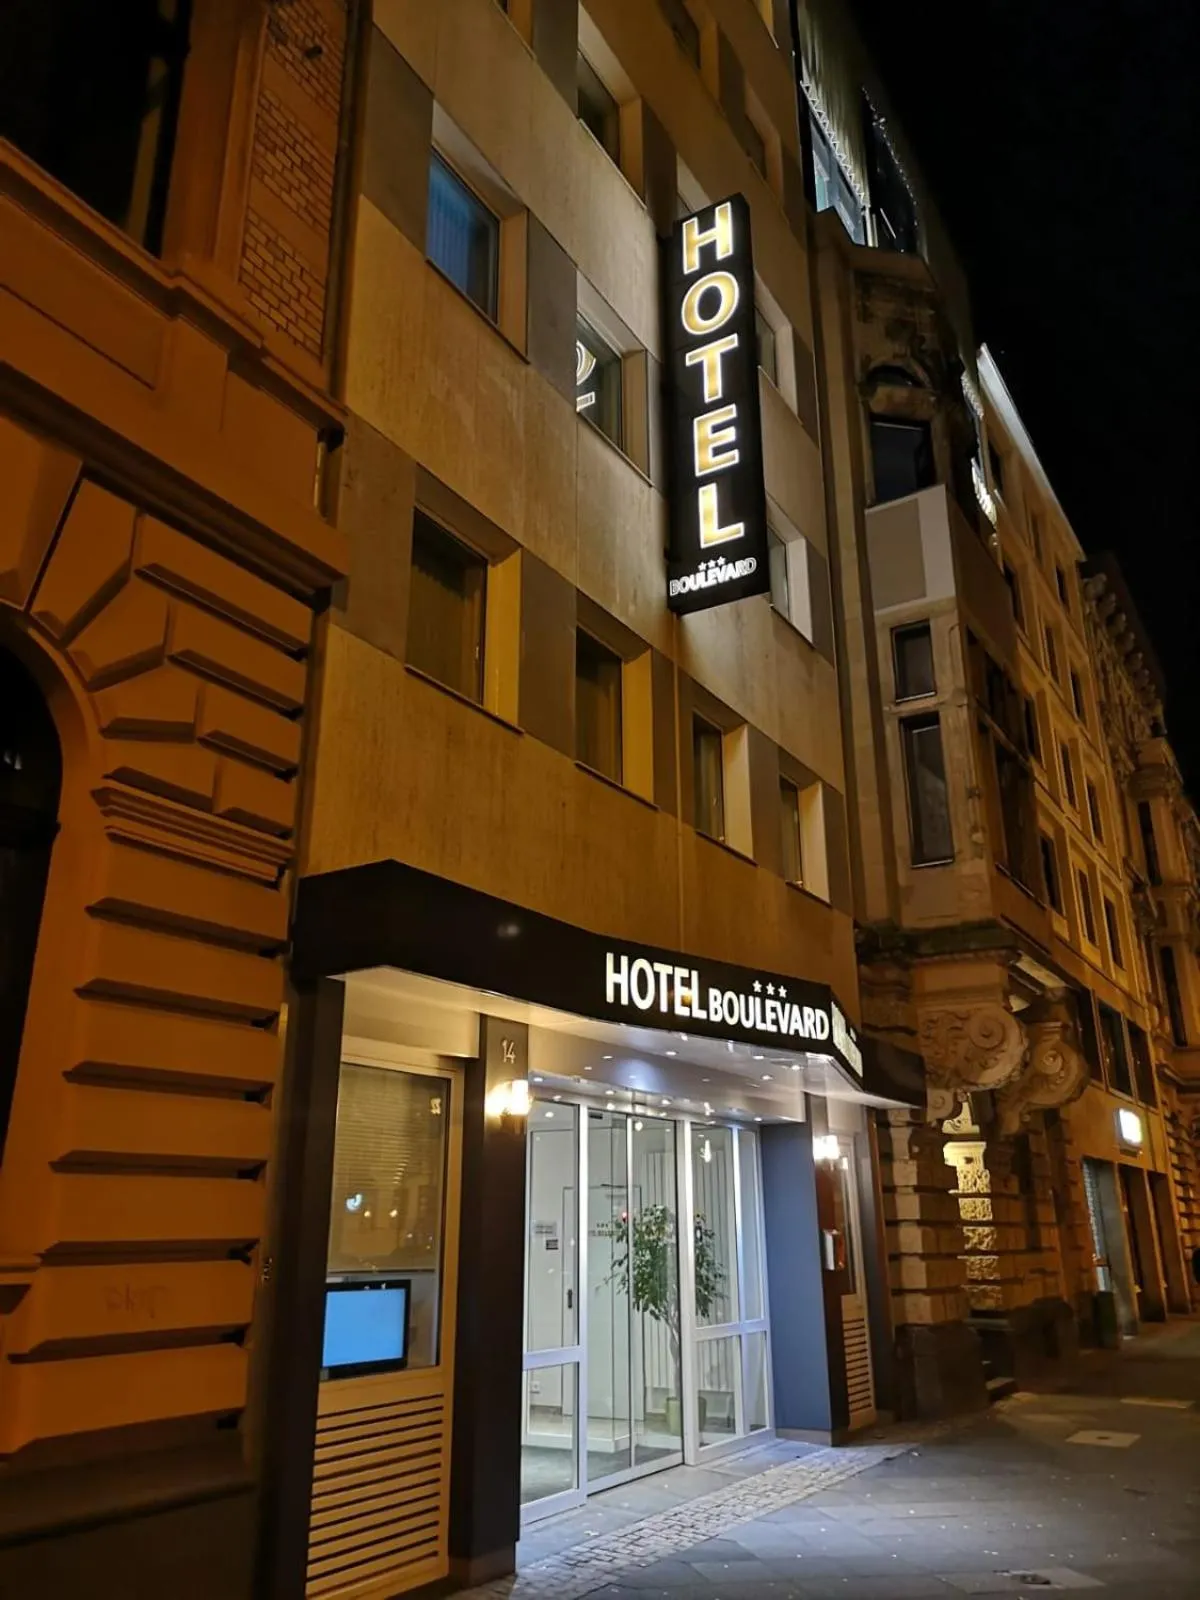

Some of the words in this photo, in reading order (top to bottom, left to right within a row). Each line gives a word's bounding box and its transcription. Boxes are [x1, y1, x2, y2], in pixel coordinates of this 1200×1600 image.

[681, 201, 744, 548] HOTEL
[669, 557, 757, 597] BOULEVARD
[606, 952, 707, 1019] HOTEL
[708, 987, 829, 1040] BOULEVARD
[502, 1039, 516, 1064] 14
